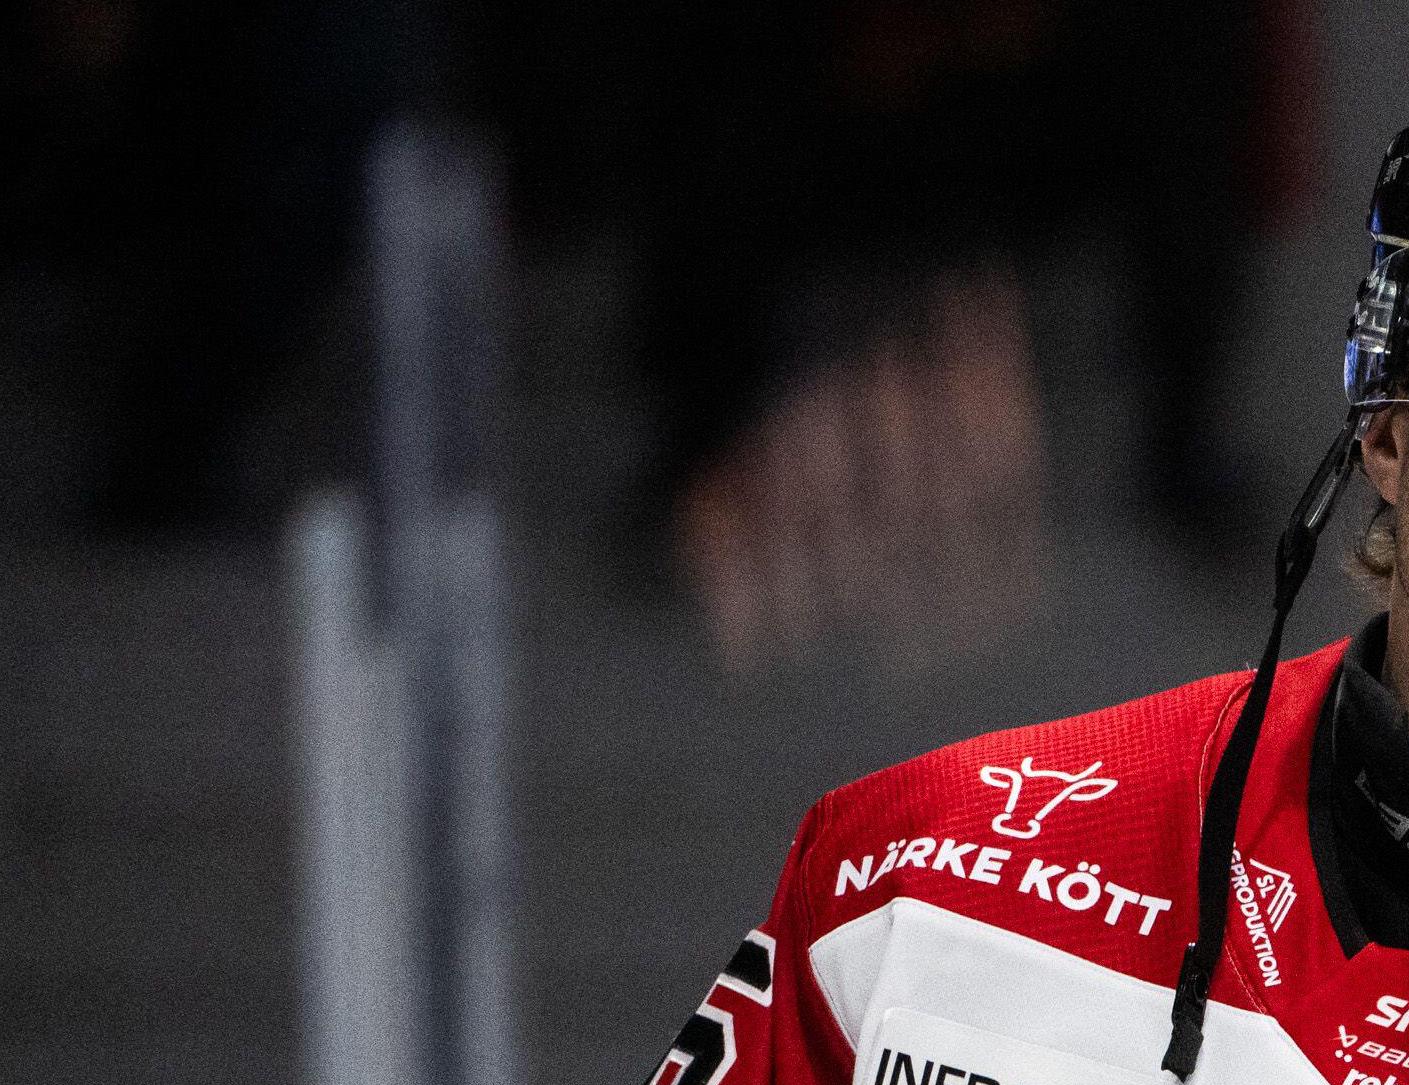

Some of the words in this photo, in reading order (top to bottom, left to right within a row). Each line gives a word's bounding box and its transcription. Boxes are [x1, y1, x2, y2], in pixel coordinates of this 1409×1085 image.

[834, 837, 1012, 897] NÄRKE
[1017, 858, 1173, 936] KÖTT
[1231, 841, 1282, 988] GPRODUKTION
[1256, 873, 1276, 898] SL
